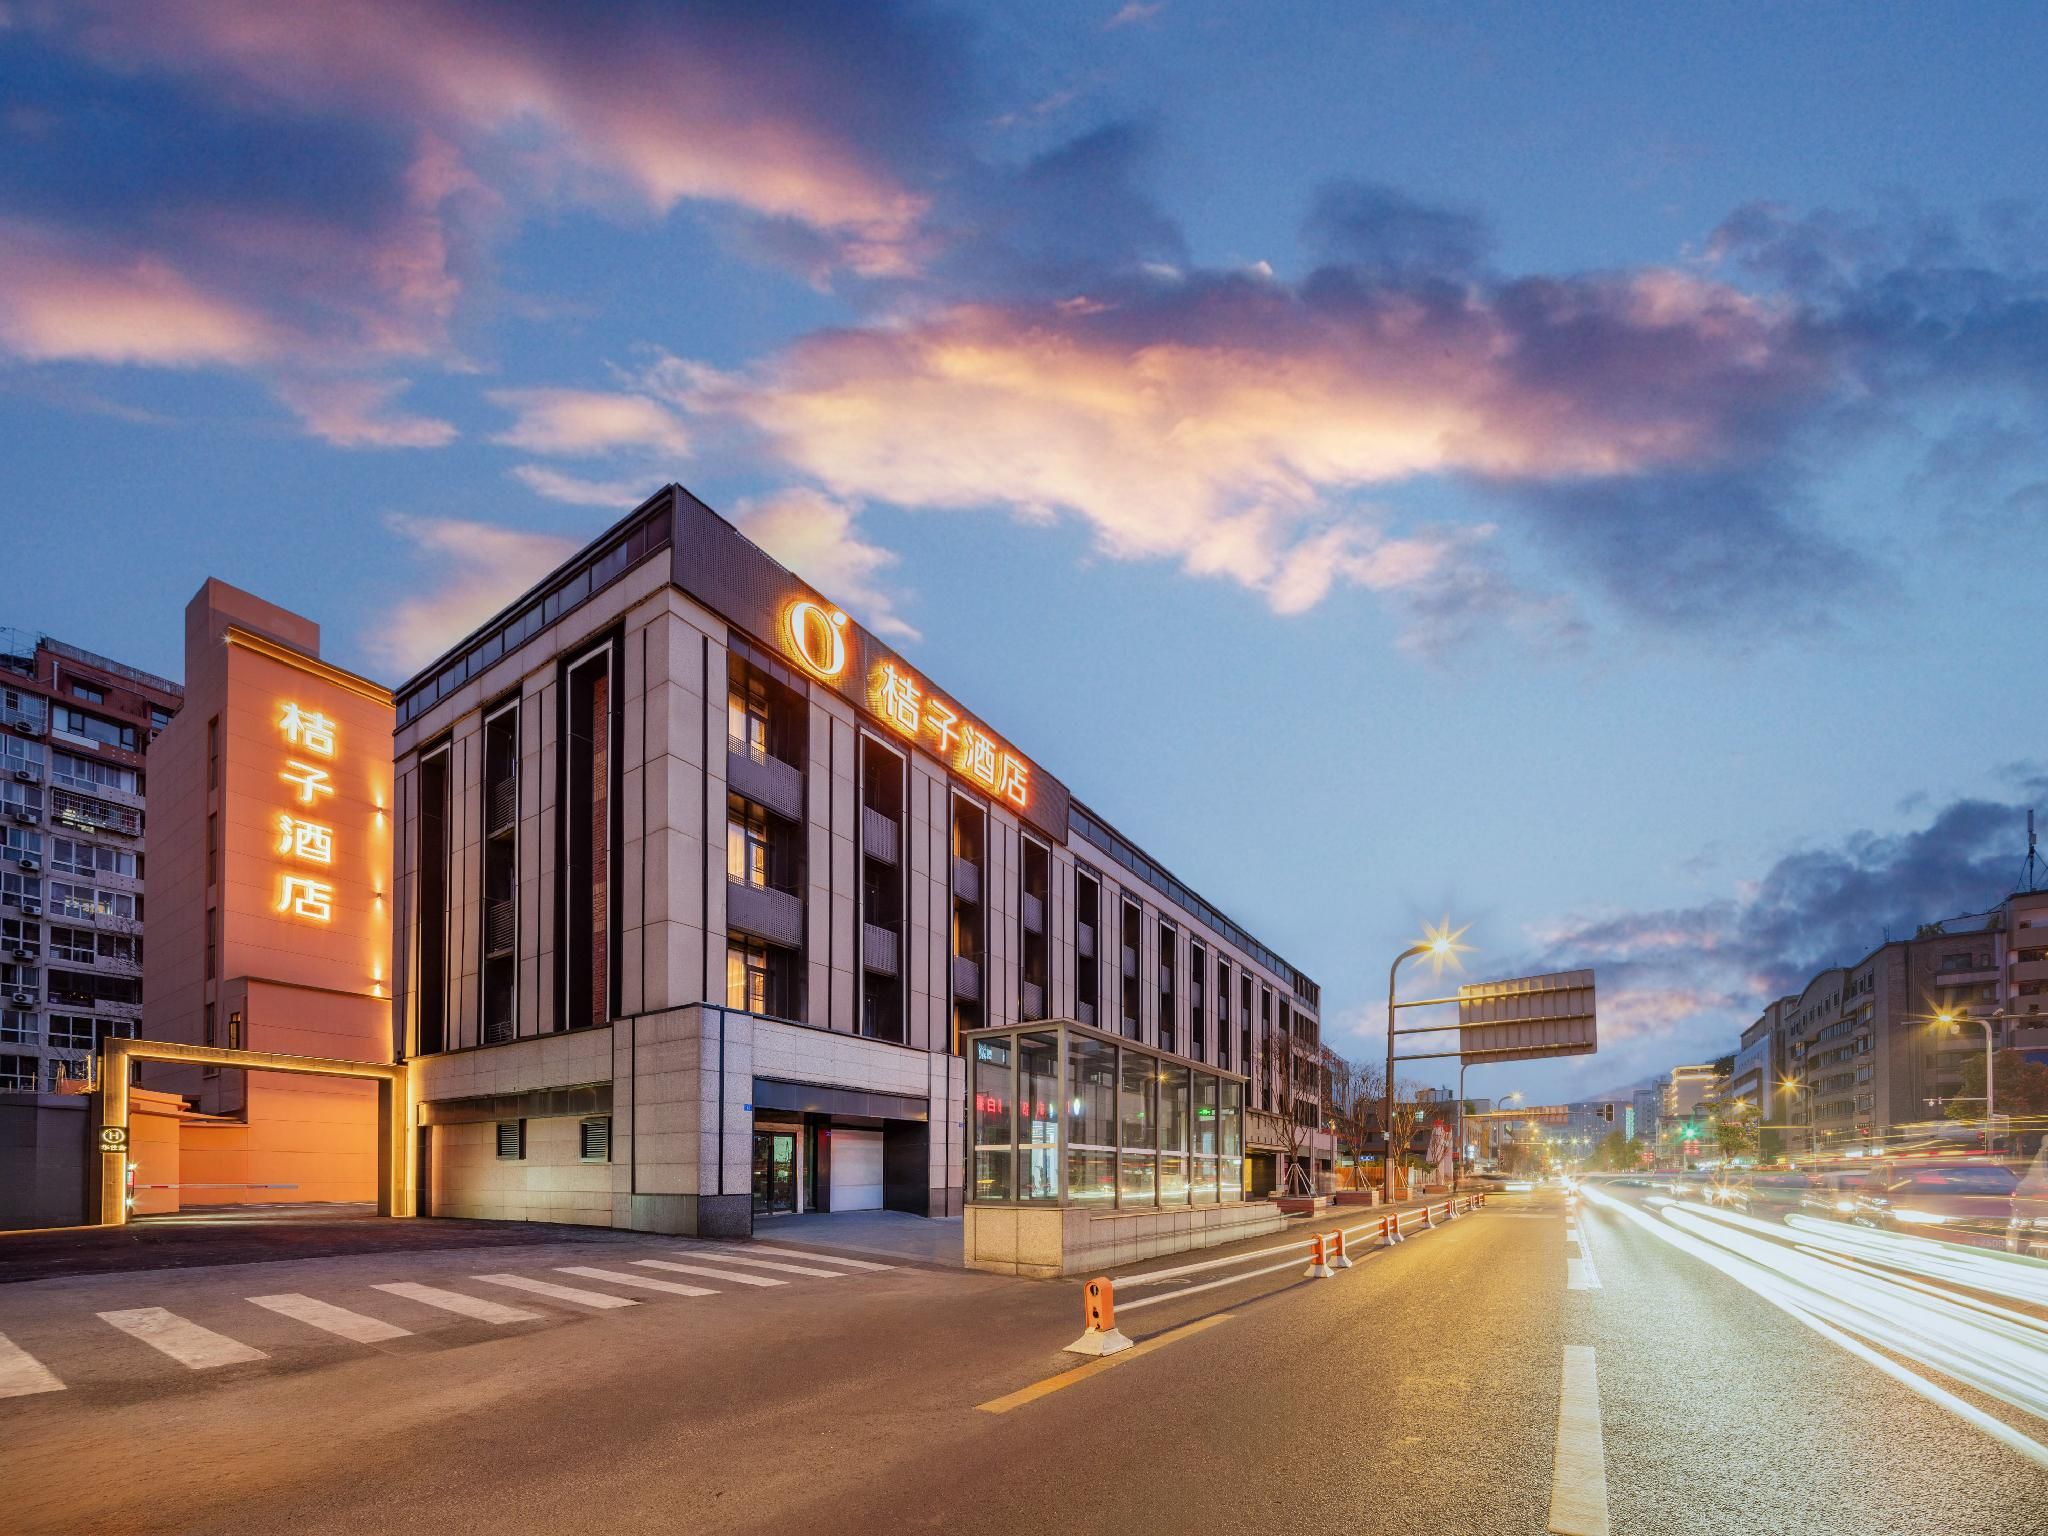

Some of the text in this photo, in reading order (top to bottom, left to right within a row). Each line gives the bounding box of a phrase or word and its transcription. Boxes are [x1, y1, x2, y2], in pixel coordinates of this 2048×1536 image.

[278, 702, 336, 922] 桔子酒店
[880, 663, 1029, 807] 桔子酒店
